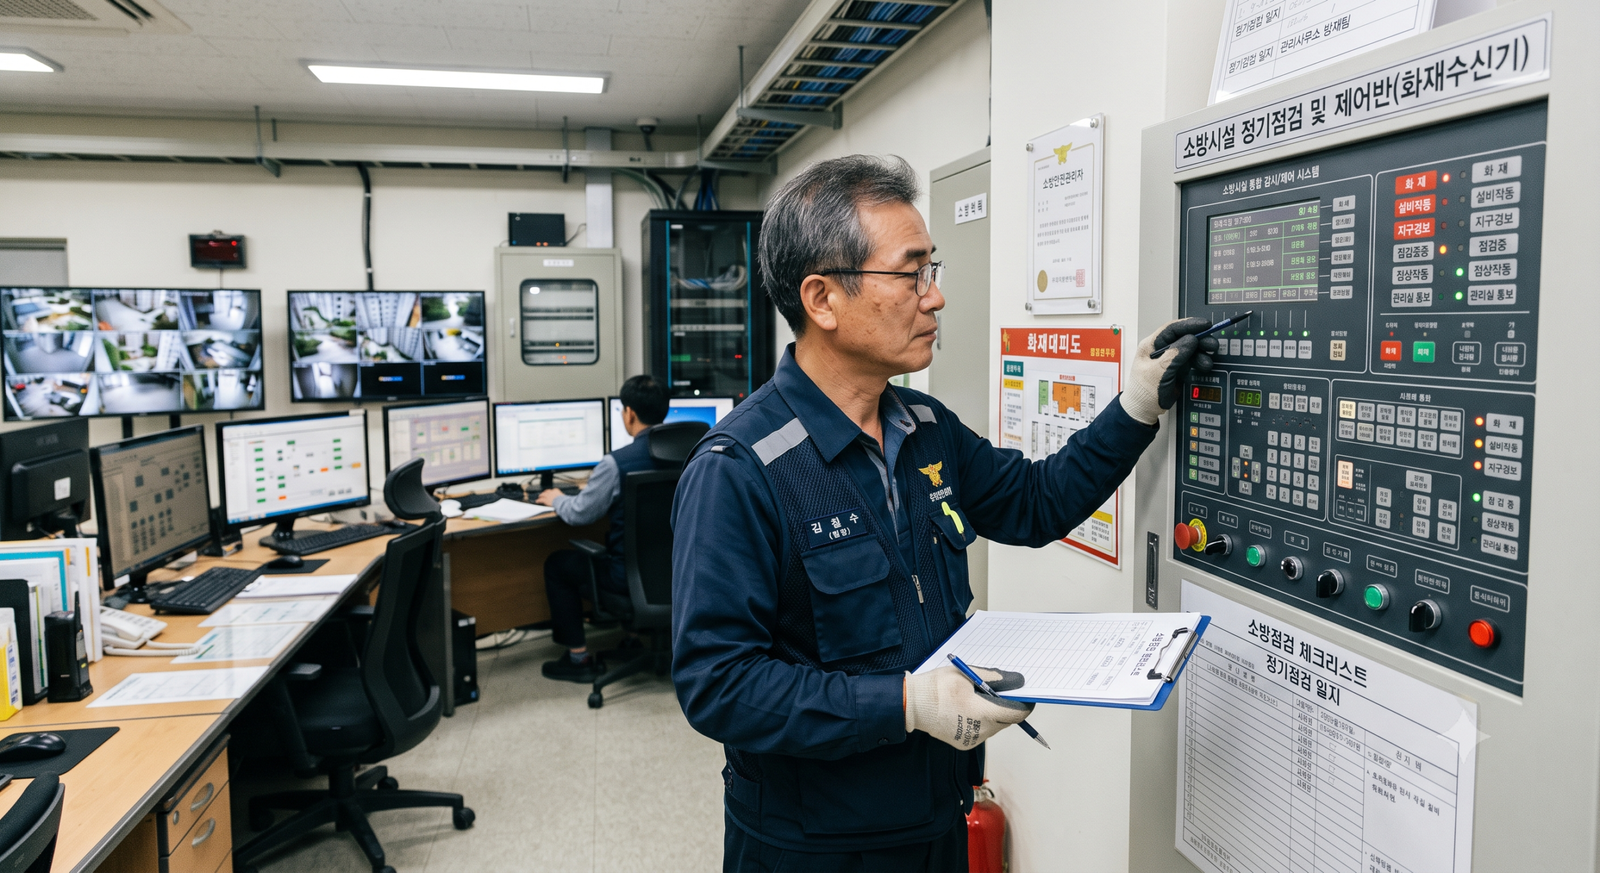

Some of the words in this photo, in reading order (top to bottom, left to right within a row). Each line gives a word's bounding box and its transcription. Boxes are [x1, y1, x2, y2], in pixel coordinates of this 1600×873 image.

[1280, 28, 1320, 53] 관리사무소
[1182, 127, 1235, 159] 소방시설
[1241, 103, 1303, 145] 정기점검
[1310, 96, 1327, 127] 및
[1334, 34, 1529, 118] 제어반(화재수신기)
[1398, 222, 1431, 237] 지구경보
[1475, 213, 1513, 228] 지구경보
[1479, 238, 1507, 253] 점검중
[1393, 292, 1414, 304] 관리실
[1470, 289, 1495, 302] 관리실
[1027, 333, 1081, 354] 화재대피도
[811, 522, 823, 534] 김
[850, 513, 859, 524] 수
[1248, 619, 1295, 655] 소방점검
[1299, 641, 1367, 688] 체크리스트
[1267, 654, 1311, 692] 정기점검
[1317, 679, 1340, 706] 일지
